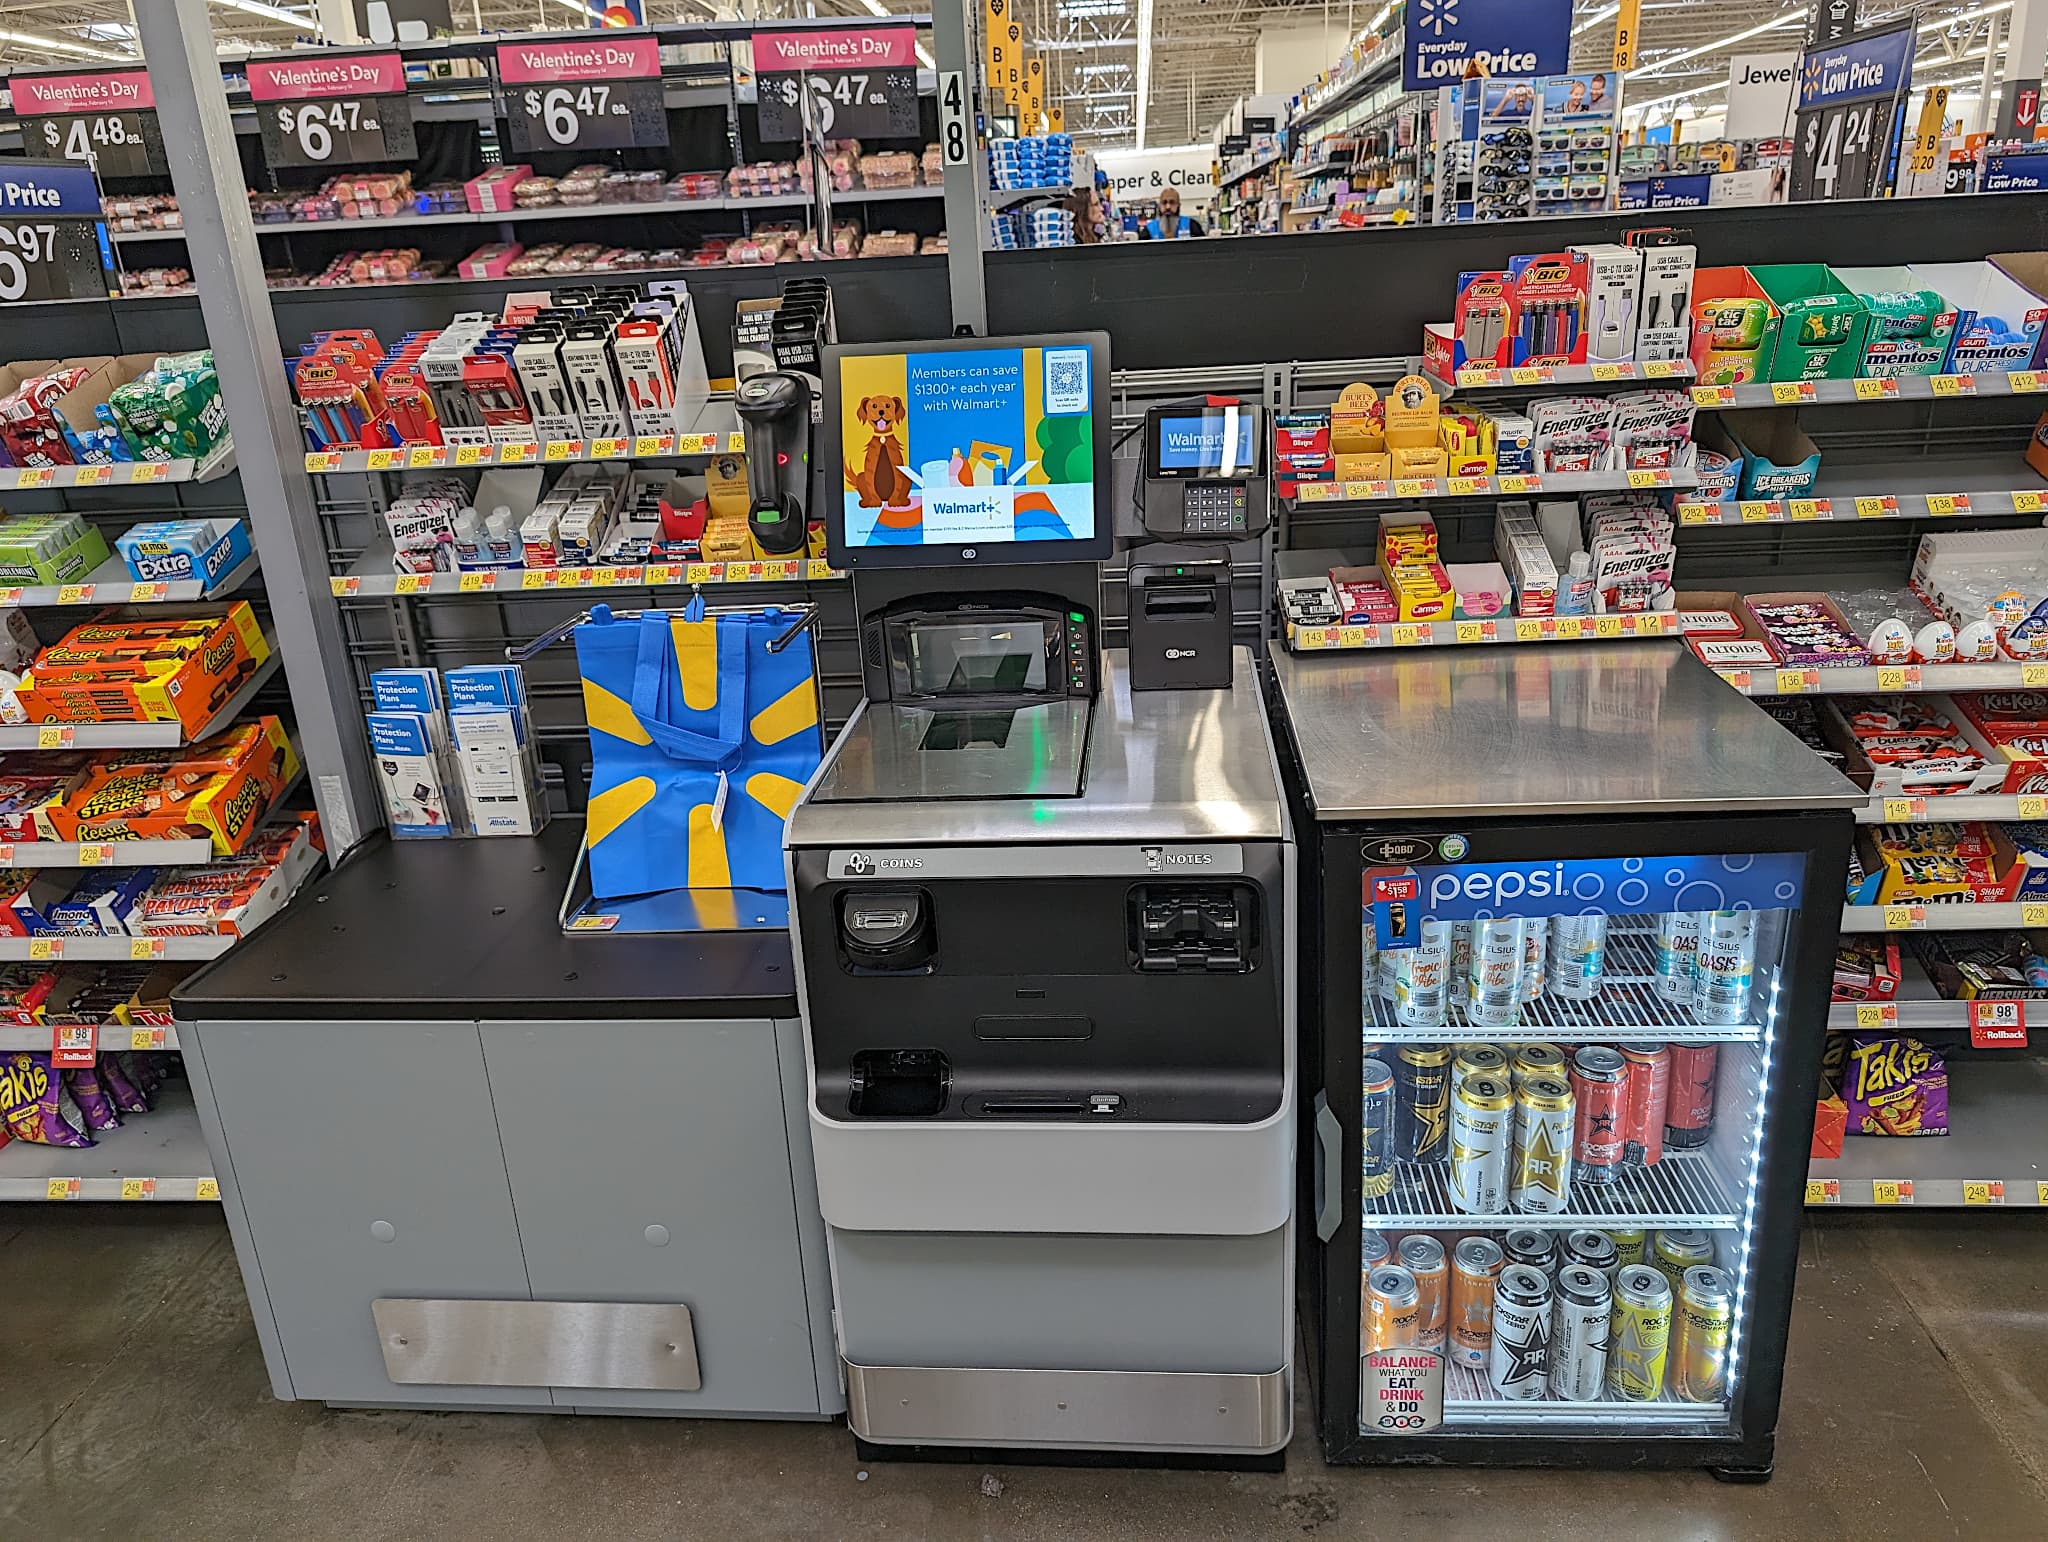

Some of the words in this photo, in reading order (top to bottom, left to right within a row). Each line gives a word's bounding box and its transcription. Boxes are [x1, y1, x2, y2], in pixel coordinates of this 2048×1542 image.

[1619, 31, 1627, 46] B
[776, 38, 858, 58] Valentine's
[861, 37, 892, 58] Day
[1418, 41, 1467, 55] Everyday
[521, 49, 602, 68] Valentine's
[606, 49, 635, 67] Day
[993, 47, 1002, 62] B
[1616, 52, 1627, 67] 18
[1825, 54, 1848, 68] Everyday
[1417, 55, 1469, 78] Low
[1475, 48, 1536, 74] Price
[269, 66, 348, 86] Valentine's
[351, 65, 379, 84] Day
[1010, 69, 1017, 82] B
[1822, 69, 1849, 95] Low
[1849, 59, 1884, 90] Price
[32, 82, 108, 101] Valentine's
[111, 81, 138, 99] Day
[1012, 89, 1018, 101] 2
[870, 93, 887, 104] ea.
[1032, 97, 1038, 108] B
[612, 103, 630, 115] ea.
[363, 119, 380, 130] ea.
[1033, 113, 1039, 123] 3
[1927, 136, 1935, 150] B
[1921, 156, 1934, 169] 20
[1108, 177, 1144, 194] aper
[1151, 171, 1162, 186] &
[1988, 180, 2010, 189] Low
[2011, 177, 2038, 187] Price
[5, 182, 60, 207] Price
[1652, 199, 1673, 207] Low
[1674, 196, 1699, 206] Price
[1722, 309, 1738, 319] tic
[1718, 318, 1738, 326] tac
[1866, 351, 1941, 364] mentos
[1954, 346, 2029, 359] mentos
[781, 357, 791, 365] CAR
[791, 354, 814, 364] CHARGER
[427, 364, 458, 372] PREMIUM
[912, 366, 967, 380] Members
[969, 368, 989, 377] can
[993, 366, 1018, 376] save
[1802, 370, 1828, 379] Sprite
[915, 383, 956, 395] $1300+
[961, 382, 987, 393] each
[991, 382, 1016, 394] year
[1345, 393, 1373, 401] BURT'S
[923, 400, 948, 411] with
[952, 398, 1007, 410] Walmart+
[1350, 400, 1369, 408] BEES
[1539, 411, 1611, 436] Energizer
[1618, 406, 1695, 432] Energizer
[1168, 433, 1225, 446] Walmart
[1459, 464, 1487, 474] Carmex
[1755, 473, 1772, 490] ICE
[1772, 472, 1811, 487] BREAKERS
[1770, 484, 1793, 492] MINTS
[933, 501, 995, 515] Walmart+
[394, 515, 445, 538] Energizer
[207, 536, 232, 577] Extra
[137, 553, 191, 581] Extra
[1601, 551, 1672, 577] Energizer
[1412, 604, 1443, 615] Carmex
[1707, 645, 1762, 654] ALTOIDS
[377, 686, 418, 694] Protection
[373, 728, 411, 737] Protection
[375, 735, 394, 744] Plans
[880, 857, 923, 870] COINS
[1165, 853, 1212, 865] NOTES
[1431, 862, 1562, 909] pepsi
[1703, 937, 1740, 951] CELSIUS
[1701, 953, 1738, 971] OASIS
[1987, 1031, 2025, 1039] Rollback
[63, 1052, 93, 1060] Rollback
[1851, 1042, 1930, 1101] Takis
[1475, 1127, 1494, 1135] DRINK
[1369, 1357, 1437, 1368] BALANCE
[1379, 1369, 1405, 1377] WHAT
[1409, 1369, 1427, 1377] YOU
[1389, 1377, 1416, 1389] EAT
[1379, 1389, 1424, 1400] DRINK
[1386, 1402, 1396, 1412] &
[1400, 1401, 1418, 1412] DO
